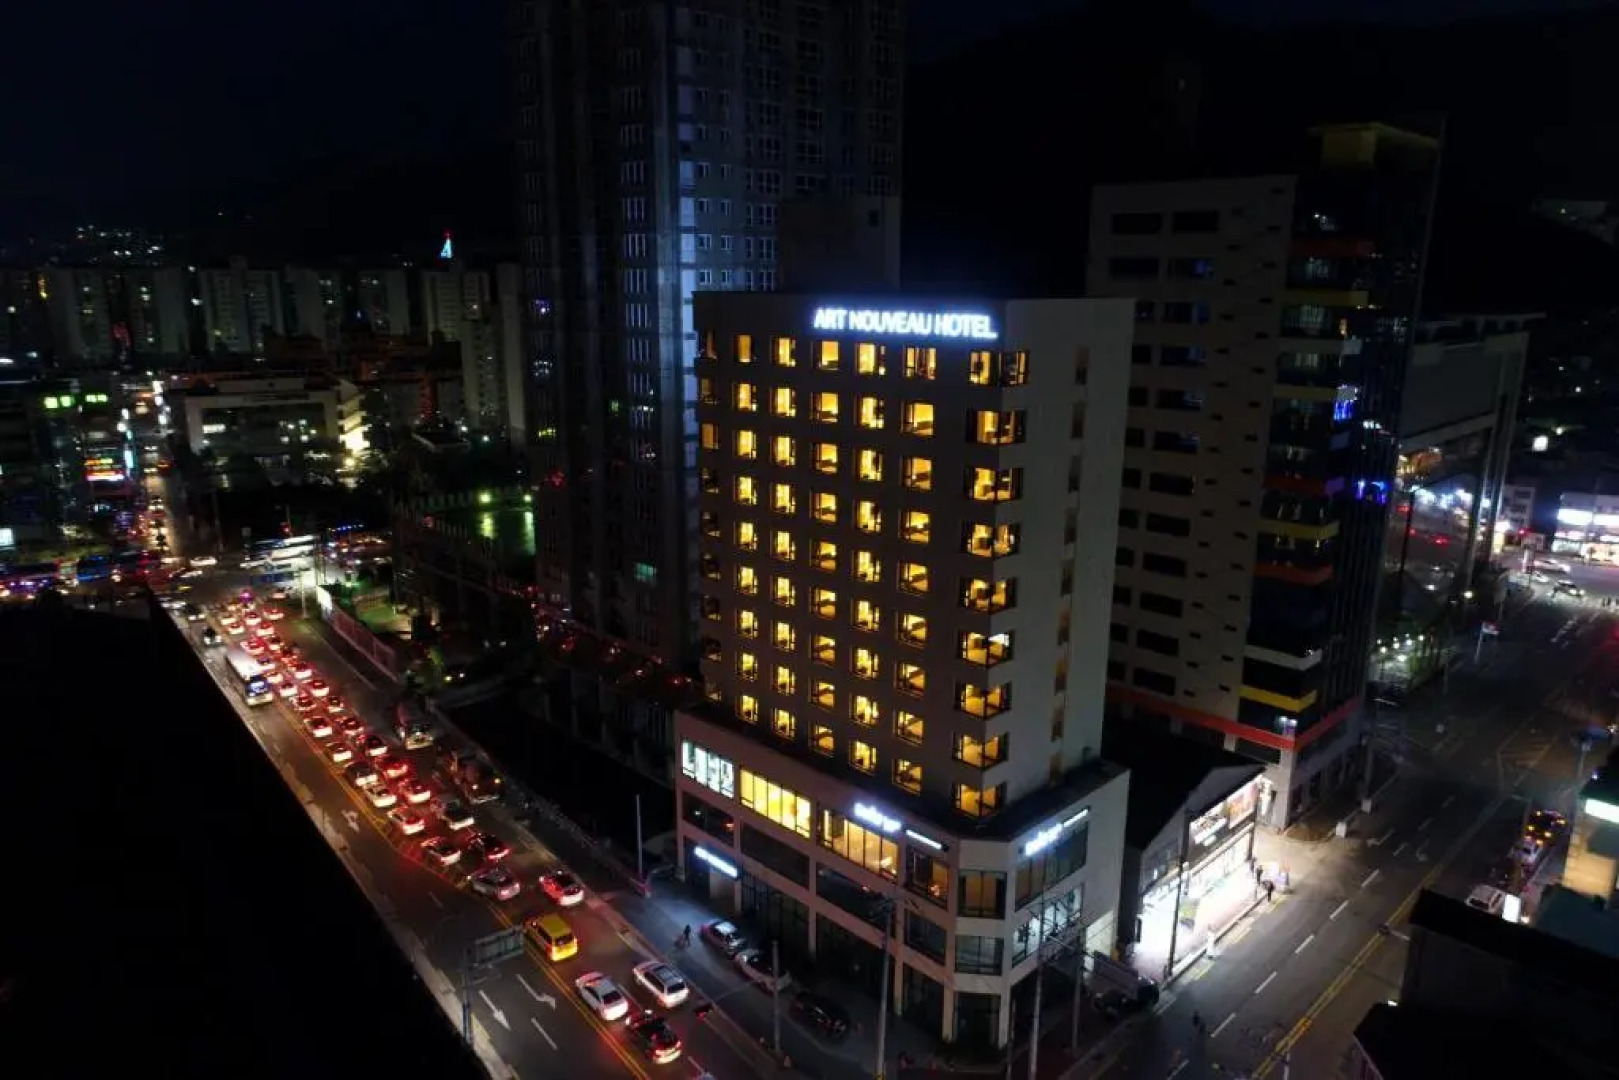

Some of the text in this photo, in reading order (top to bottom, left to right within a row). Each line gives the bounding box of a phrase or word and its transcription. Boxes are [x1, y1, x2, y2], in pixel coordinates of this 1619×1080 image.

[813, 308, 998, 339] ART NOUVEAU HOTEL
